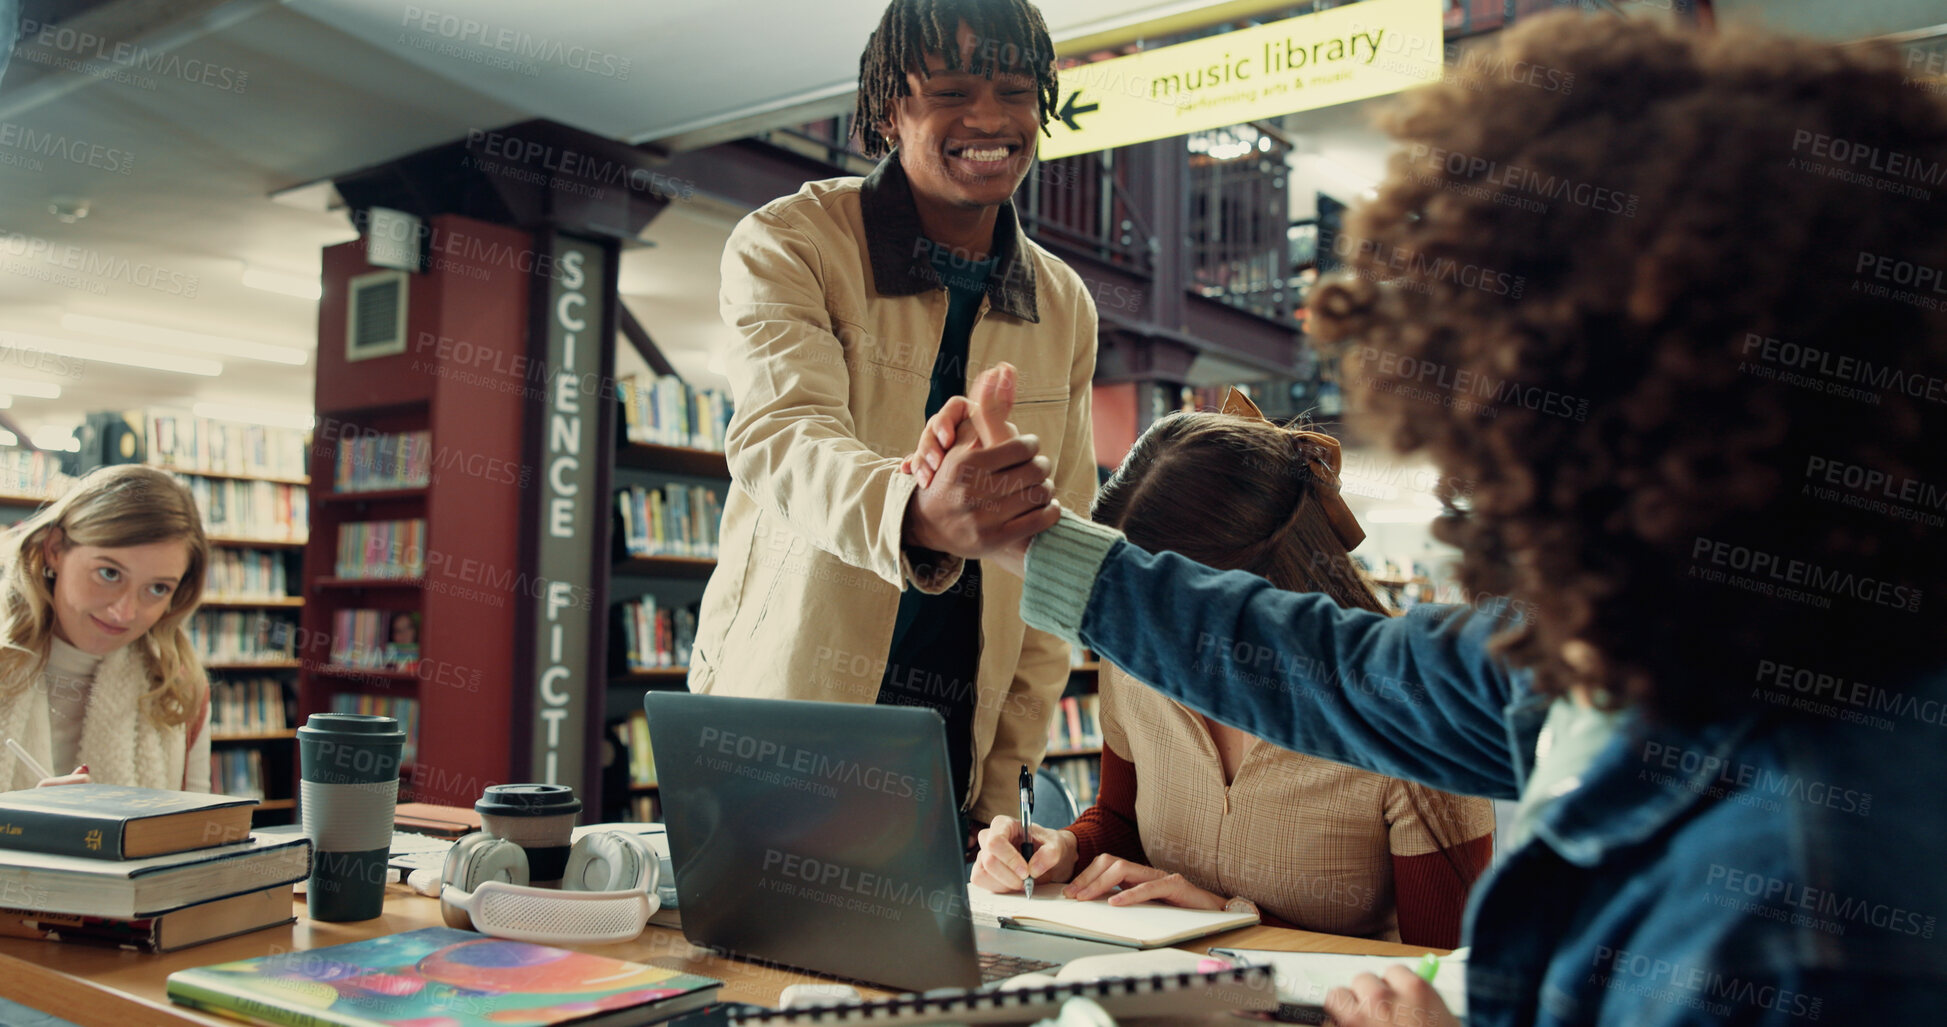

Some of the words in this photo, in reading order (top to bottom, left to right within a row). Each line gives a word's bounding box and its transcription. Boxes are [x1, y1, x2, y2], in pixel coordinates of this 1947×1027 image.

[1153, 53, 1250, 97] music
[1264, 29, 1386, 74] library
[1176, 90, 1257, 116] performing
[1264, 83, 1287, 97] arts
[549, 250, 586, 538] SCIENCE
